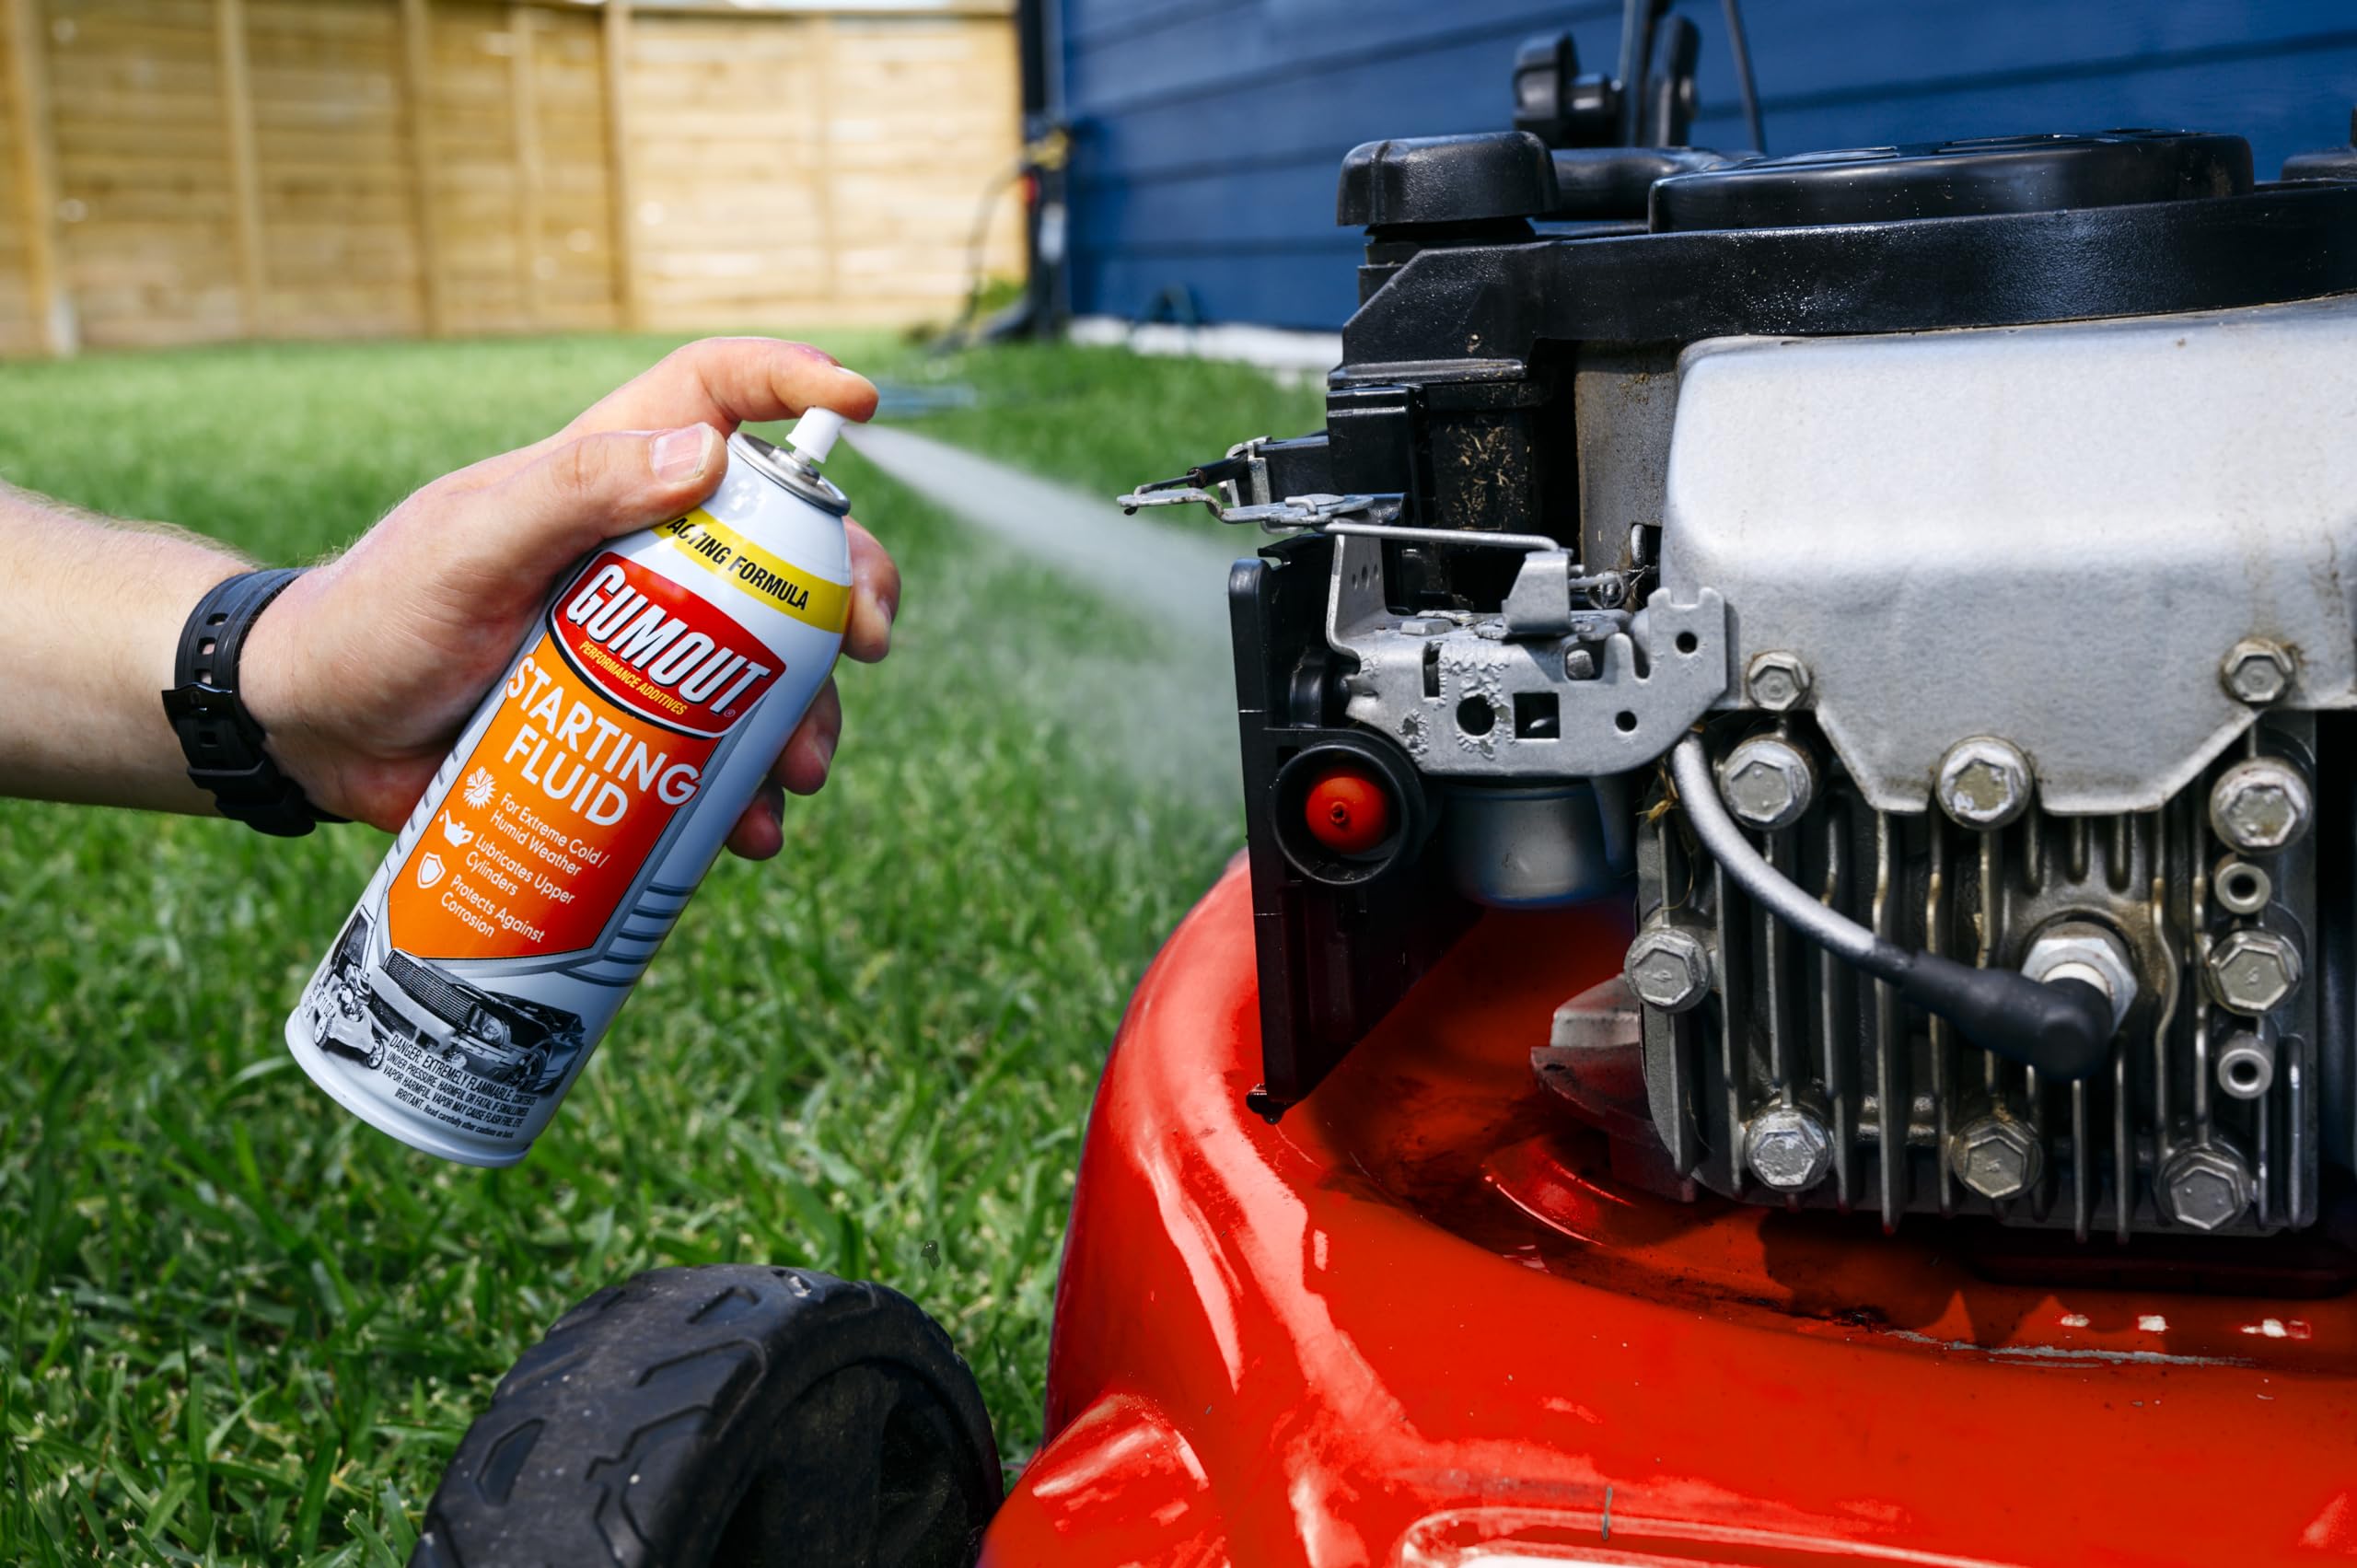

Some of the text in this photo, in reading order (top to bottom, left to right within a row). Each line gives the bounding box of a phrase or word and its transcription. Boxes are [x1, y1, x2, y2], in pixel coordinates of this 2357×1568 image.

[666, 517, 810, 610] ACTING FORMULA
[566, 563, 772, 715] GUMOUT
[579, 641, 689, 715] PERFORMANCE ADDITIVES
[507, 656, 702, 805] STARTING
[503, 723, 629, 826] FLUID
[490, 809, 582, 877] Humid Weather
[500, 793, 520, 816] For
[518, 807, 568, 847] Extreme
[568, 839, 603, 865] Cold
[465, 851, 519, 897] Cylinders
[475, 833, 575, 905] Lubricates Upper
[441, 891, 495, 938] Corrosion
[450, 874, 546, 944] Protects Against
[383, 1063, 406, 1082] VAPOR
[432, 1091, 456, 1110] VAPOR
[451, 1101, 468, 1115] MAY
[465, 1108, 487, 1121] CAUSE
[387, 1051, 408, 1069] UNDER
[437, 1080, 468, 1101] HARMFUL
[465, 1093, 475, 1104] OR
[474, 1096, 495, 1110] FATAL
[389, 1034, 424, 1063] DANGER:
[422, 1054, 470, 1086] EXTREMELY
[395, 1087, 423, 1110] IRRITANT.
[424, 1104, 439, 1117] Read
